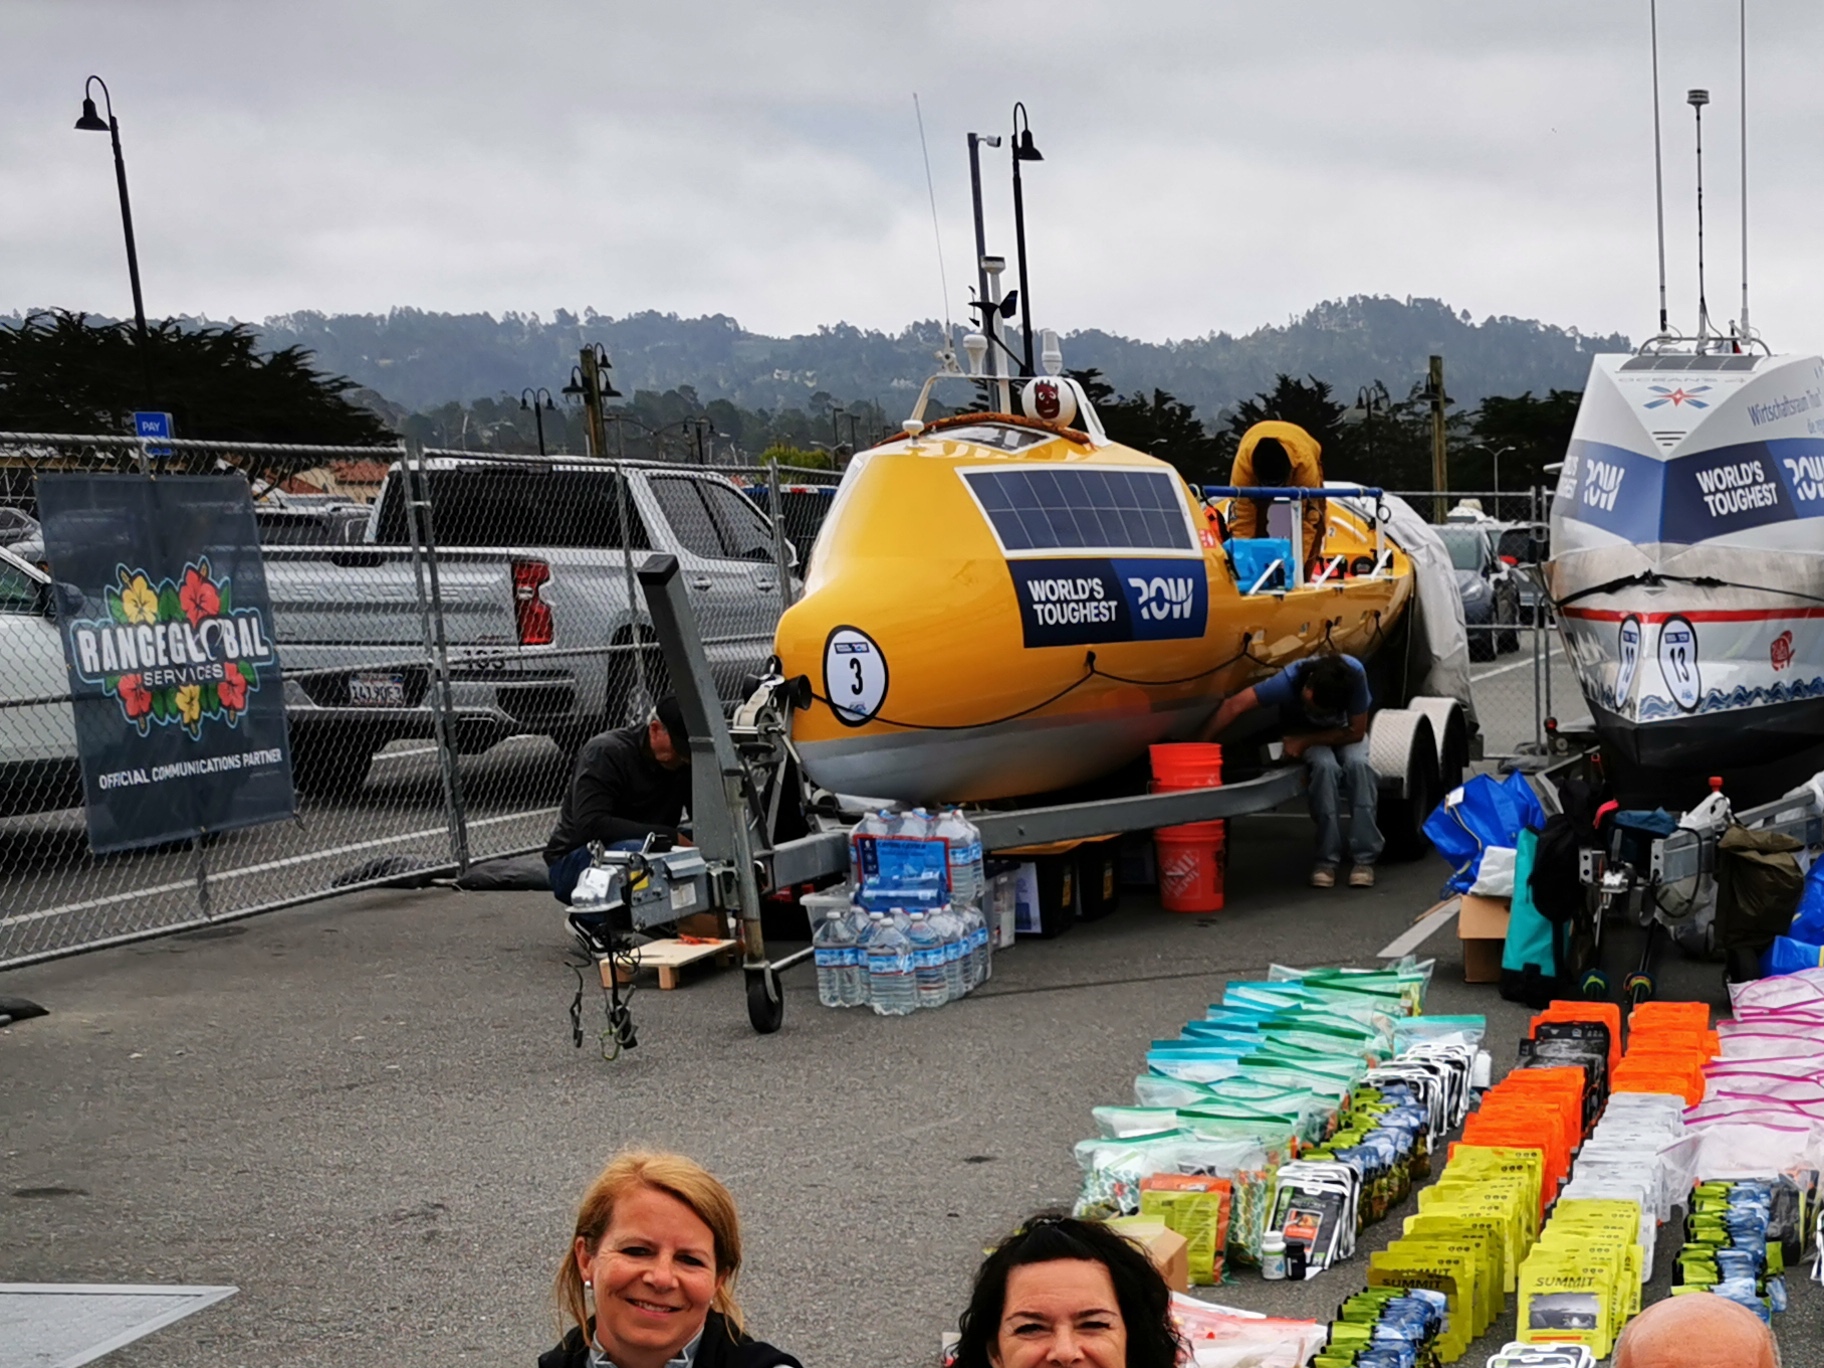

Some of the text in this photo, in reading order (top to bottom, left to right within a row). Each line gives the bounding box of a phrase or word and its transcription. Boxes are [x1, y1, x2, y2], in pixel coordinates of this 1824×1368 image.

[142, 421, 161, 431] PAY
[1696, 460, 1765, 494] WORLD'S
[1703, 482, 1778, 517] TOUGHEST
[1027, 578, 1104, 602] WORLD'S
[1128, 577, 1194, 620] ROW
[1033, 601, 1118, 626] TOUGHEST
[77, 617, 269, 673] RANGEGLOBAL
[143, 664, 224, 686] SERVICES
[849, 657, 863, 696] 3
[1669, 647, 1690, 684] 13
[99, 748, 283, 790] OFFICIAL COMMUNICATIONS PARTNER
[1382, 1278, 1444, 1289] SUMMIT
[1535, 1276, 1596, 1288] SUMMIT
